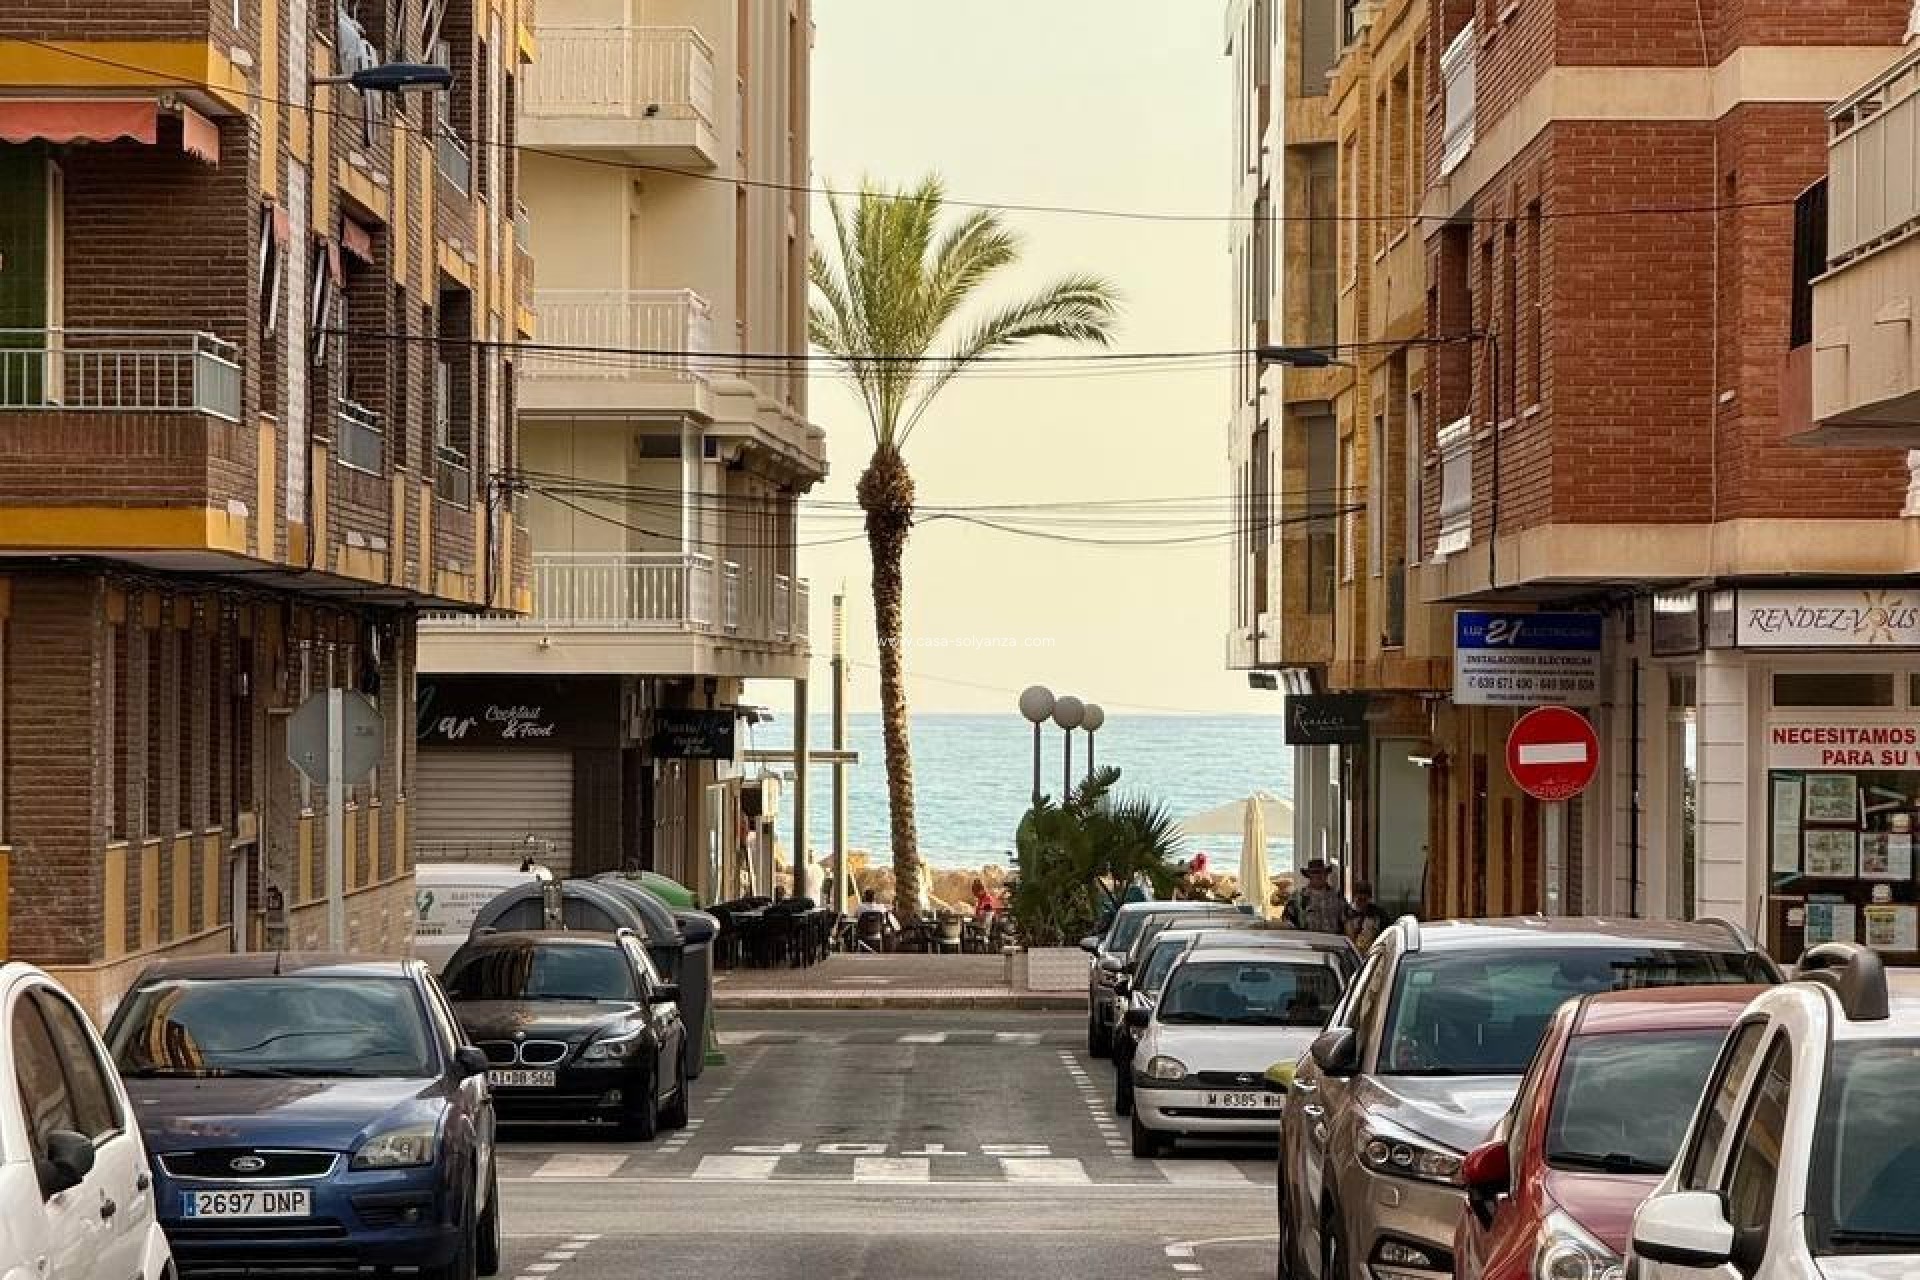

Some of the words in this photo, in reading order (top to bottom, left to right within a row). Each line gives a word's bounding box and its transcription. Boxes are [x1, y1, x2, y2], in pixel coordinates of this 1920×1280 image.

[1485, 619, 1525, 645] 21
[485, 704, 541, 721] Cocktail
[1773, 727, 1917, 745] NECESITAMOS
[1823, 750, 1874, 765] PARA
[1881, 750, 1908, 765] SU
[199, 1192, 255, 1215] 2697
[263, 1191, 305, 1213] DNP
